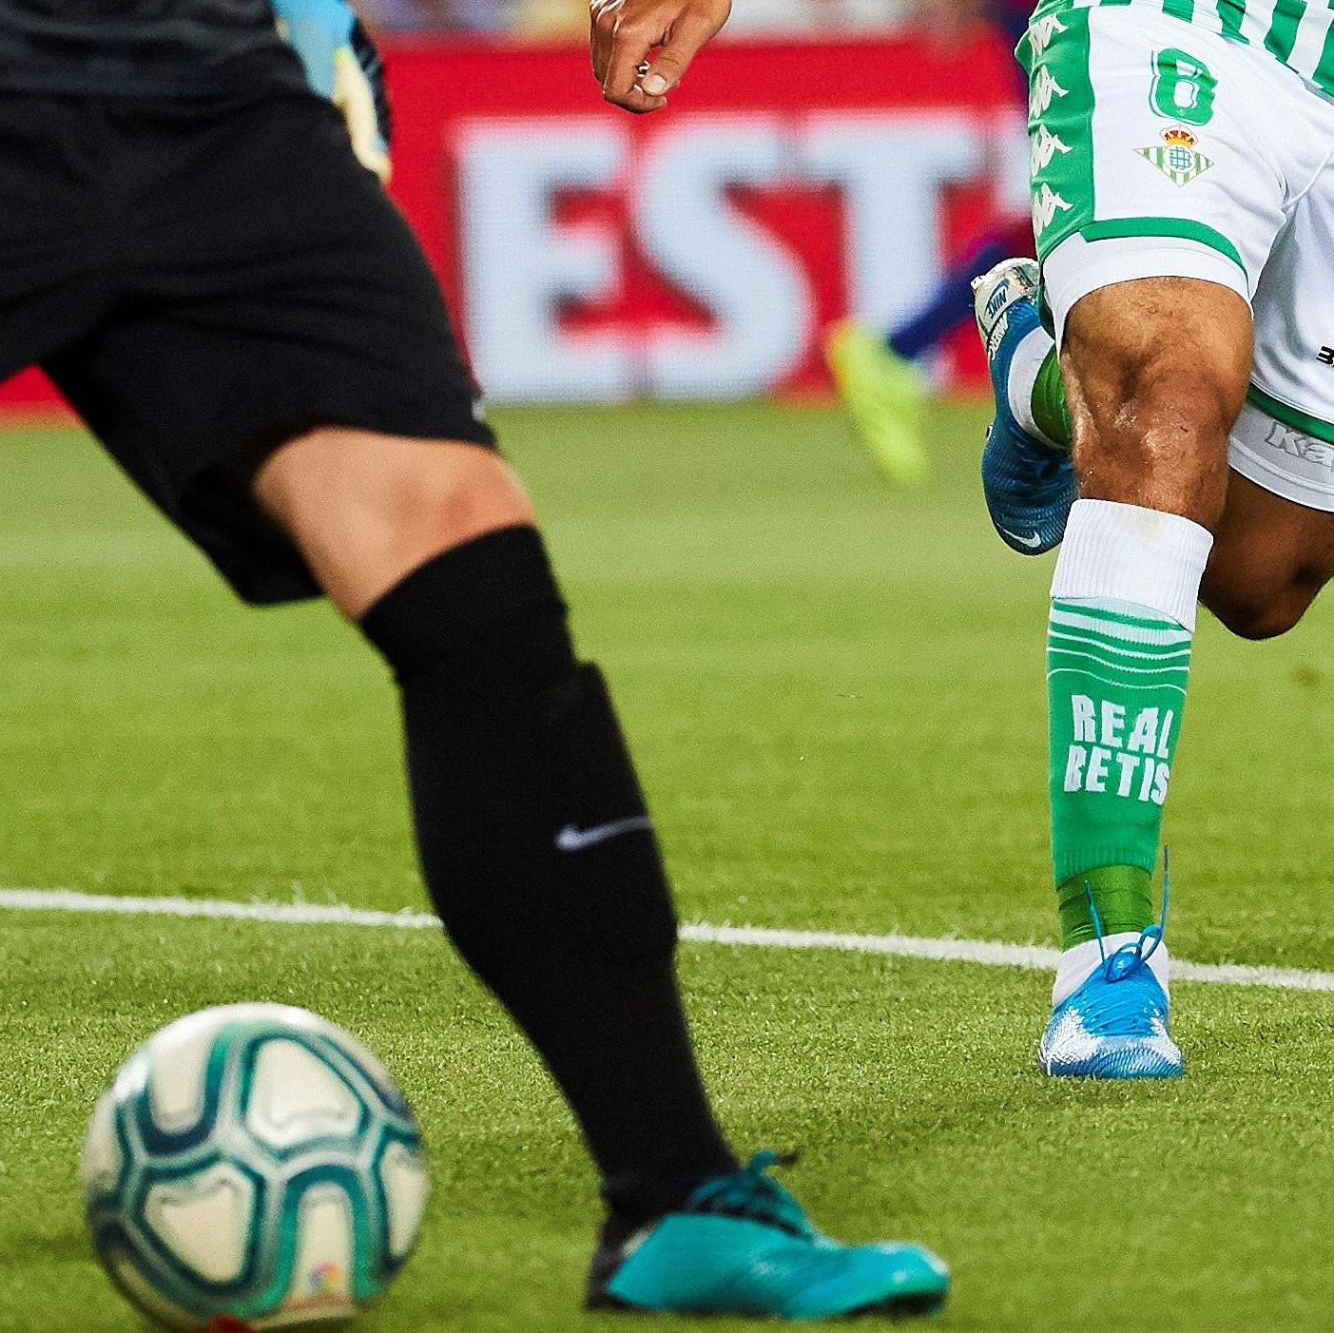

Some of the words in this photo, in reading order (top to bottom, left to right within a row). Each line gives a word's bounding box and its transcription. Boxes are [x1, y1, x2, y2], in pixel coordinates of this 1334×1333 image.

[1148, 43, 1219, 127] 8
[1070, 694, 1174, 759] REAL
[1063, 744, 1171, 806] BETIS
